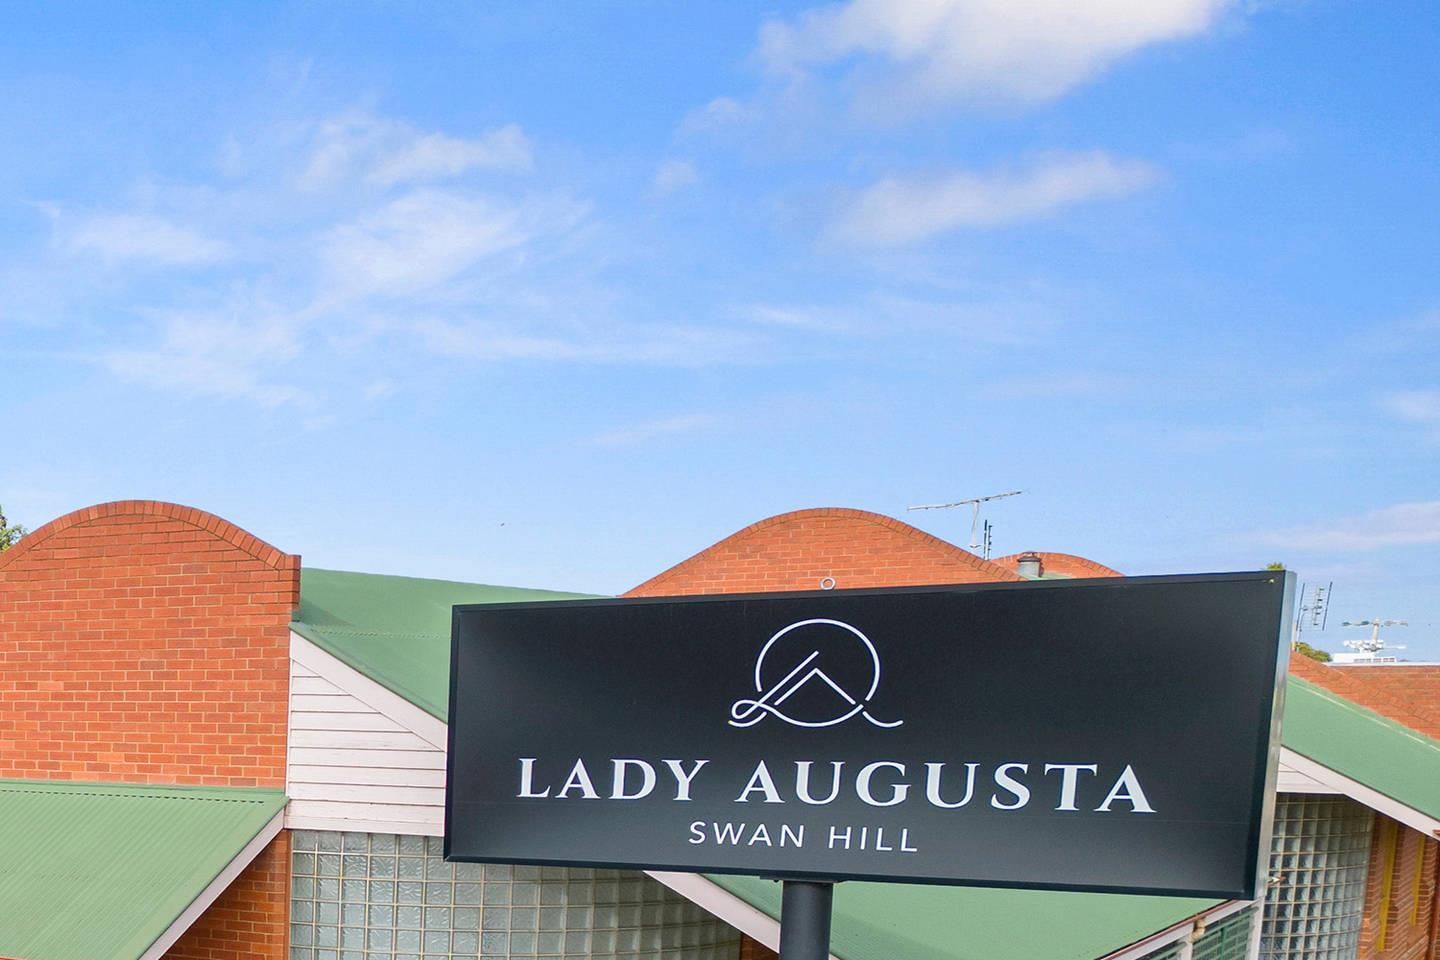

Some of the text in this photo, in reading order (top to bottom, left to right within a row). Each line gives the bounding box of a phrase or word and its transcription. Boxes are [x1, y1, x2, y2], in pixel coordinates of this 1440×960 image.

[516, 757, 1159, 814] LADY AUGUSTA
[687, 820, 919, 853] SWAN HILL
